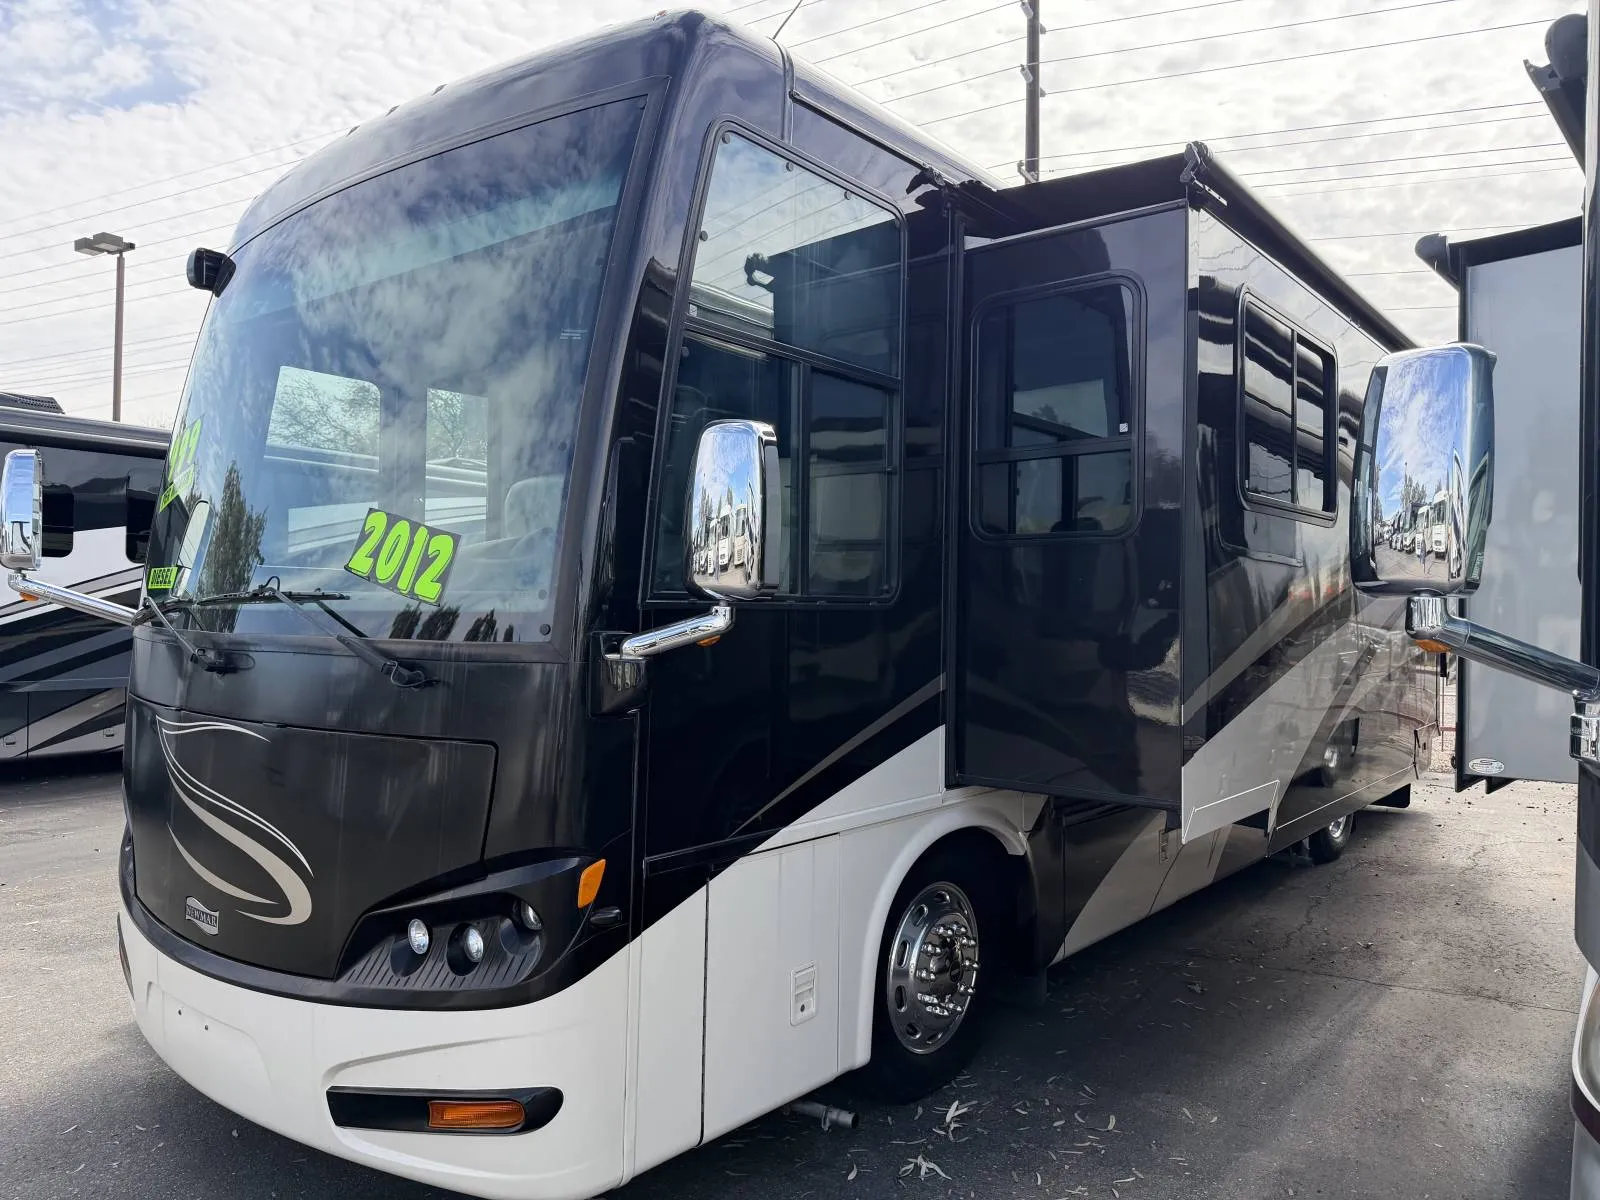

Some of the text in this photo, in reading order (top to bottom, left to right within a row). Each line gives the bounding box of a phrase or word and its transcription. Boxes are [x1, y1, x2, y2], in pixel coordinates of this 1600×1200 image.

[347, 511, 454, 603] 2012
[150, 568, 173, 586] DIESEL
[186, 904, 218, 928] NEWMAR
